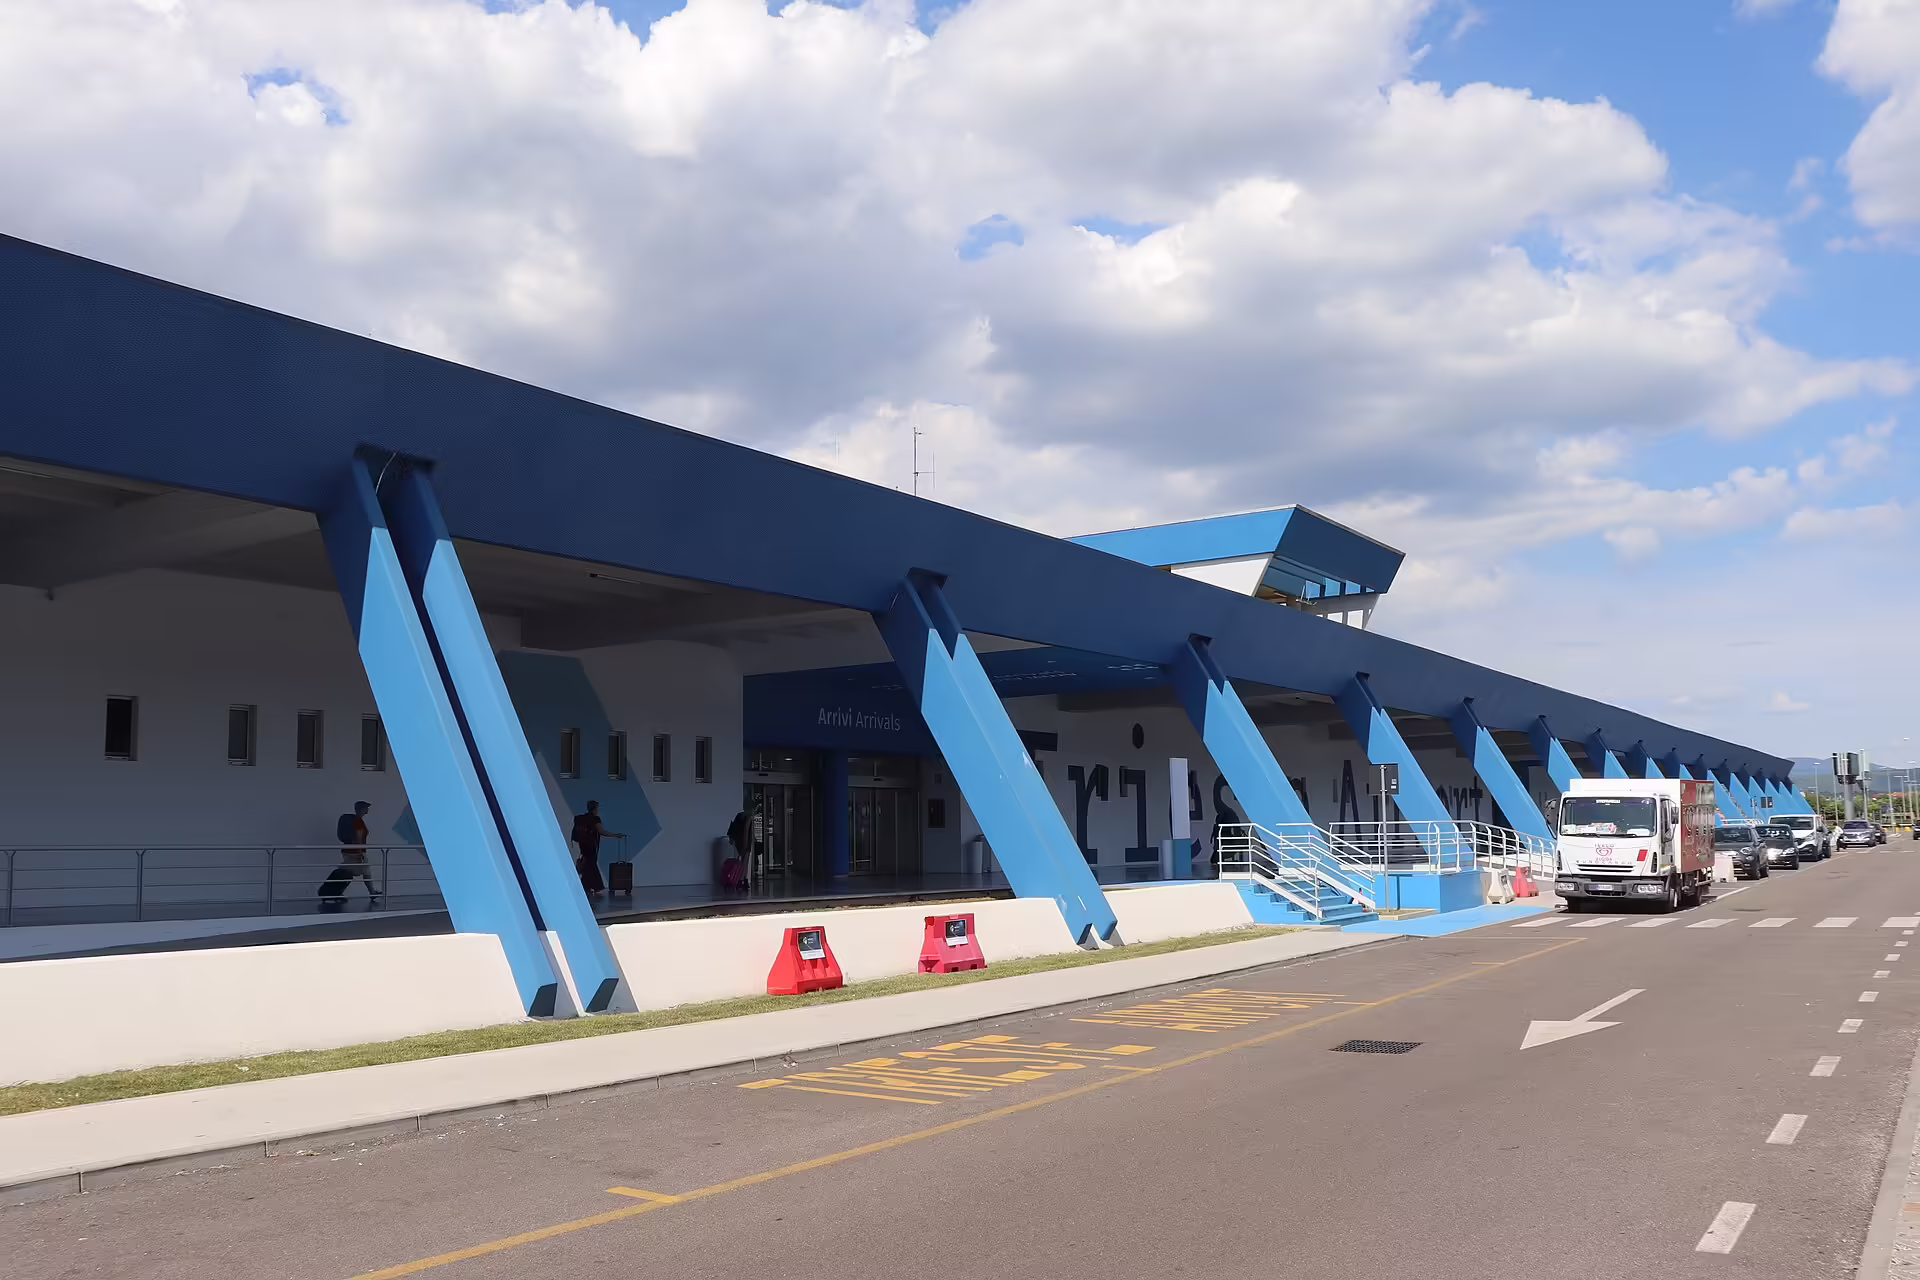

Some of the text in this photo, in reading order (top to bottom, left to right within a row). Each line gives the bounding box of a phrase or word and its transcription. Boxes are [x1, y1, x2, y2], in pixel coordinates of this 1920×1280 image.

[818, 707, 901, 731] Arrivi Arrivals
[737, 988, 1346, 1105] TRIESTE AIRPORT
